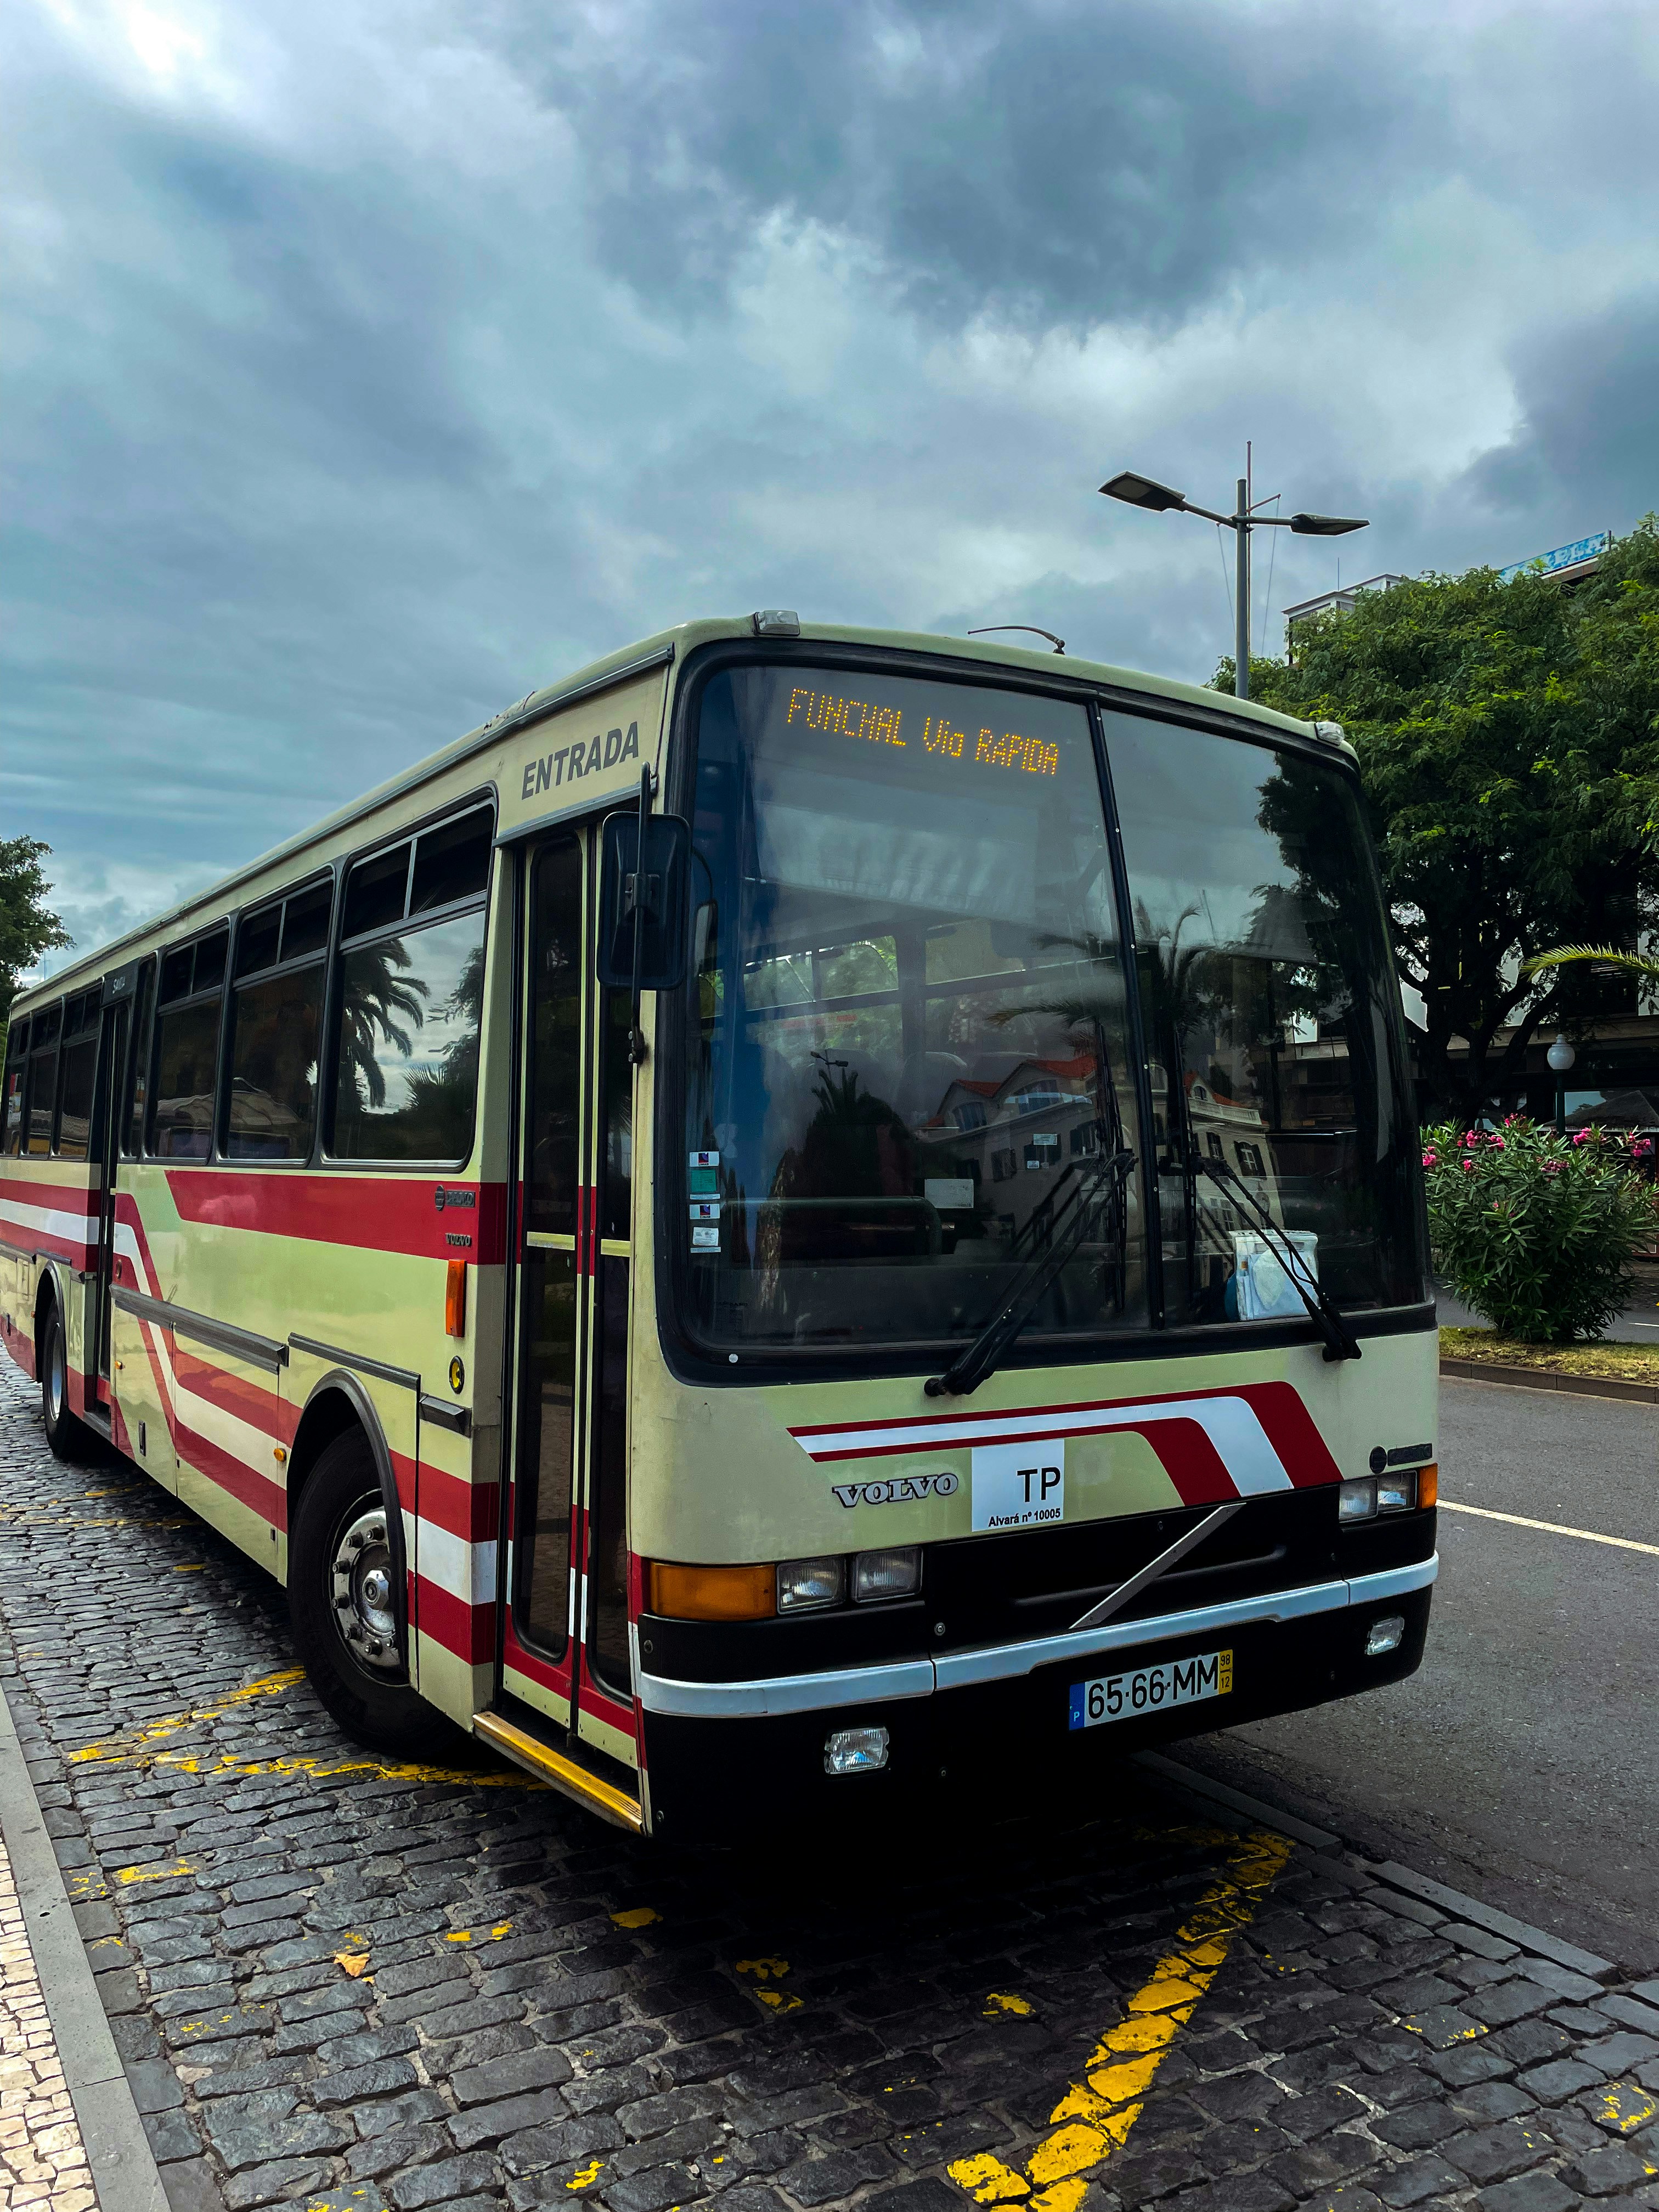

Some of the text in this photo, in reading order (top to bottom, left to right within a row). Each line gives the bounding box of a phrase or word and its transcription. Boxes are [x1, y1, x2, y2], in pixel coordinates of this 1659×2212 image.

[787, 688, 906, 747] FUNCHAL
[975, 728, 1059, 775] RAPIDA
[522, 721, 639, 800] ENTRADA
[832, 1472, 958, 1508] VOLVO
[1017, 1466, 1060, 1503] TP
[988, 1511, 1019, 1527] Alvará
[1034, 1508, 1060, 1521] 10005
[1220, 1654, 1231, 1666] 98
[1221, 1676, 1230, 1689] 12
[1073, 1712, 1080, 1722] P
